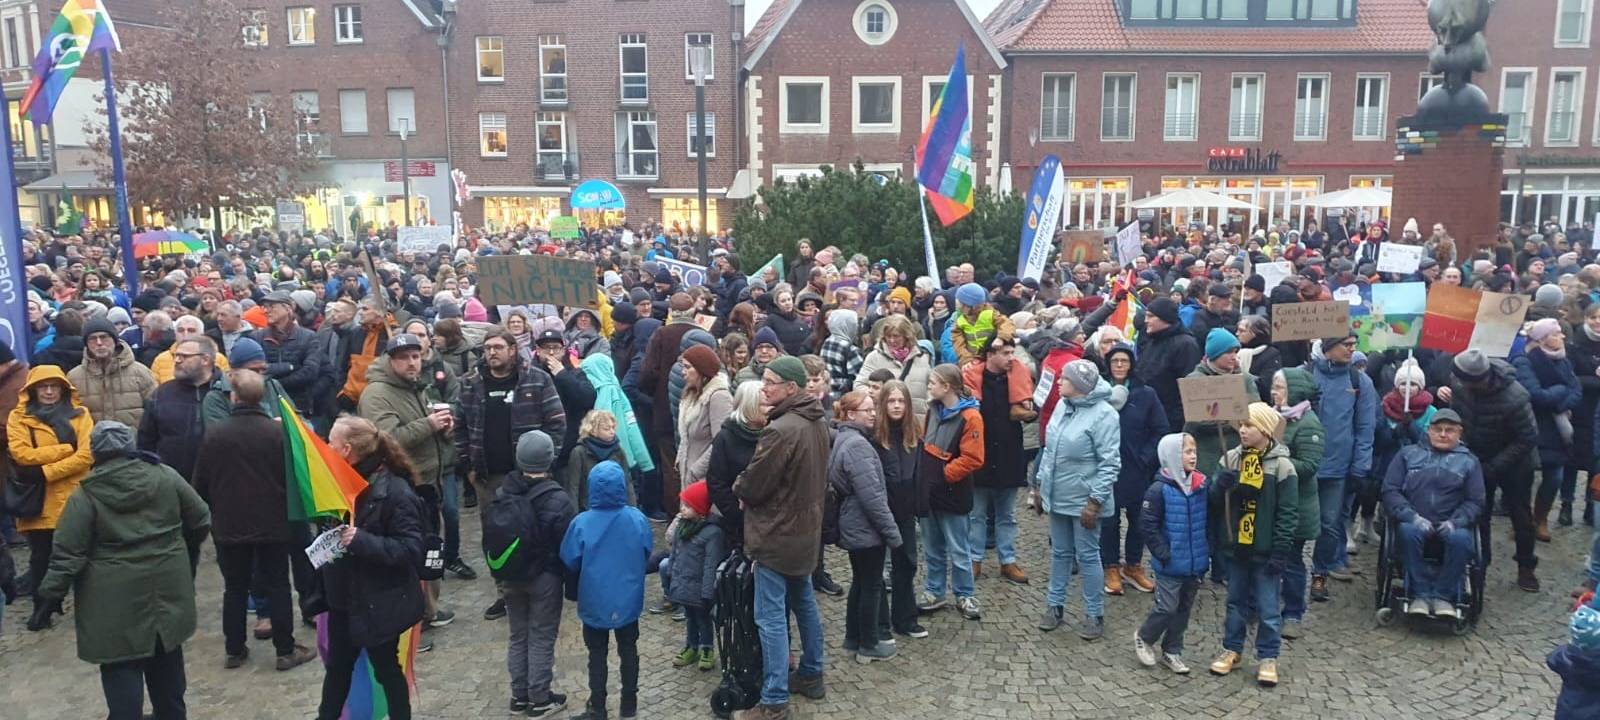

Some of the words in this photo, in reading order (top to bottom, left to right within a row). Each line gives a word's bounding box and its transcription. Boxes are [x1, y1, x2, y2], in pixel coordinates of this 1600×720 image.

[1206, 148, 1282, 172] extrablatt
[1028, 193, 1056, 266] Partnerschaft
[491, 277, 594, 305] NICHT!
